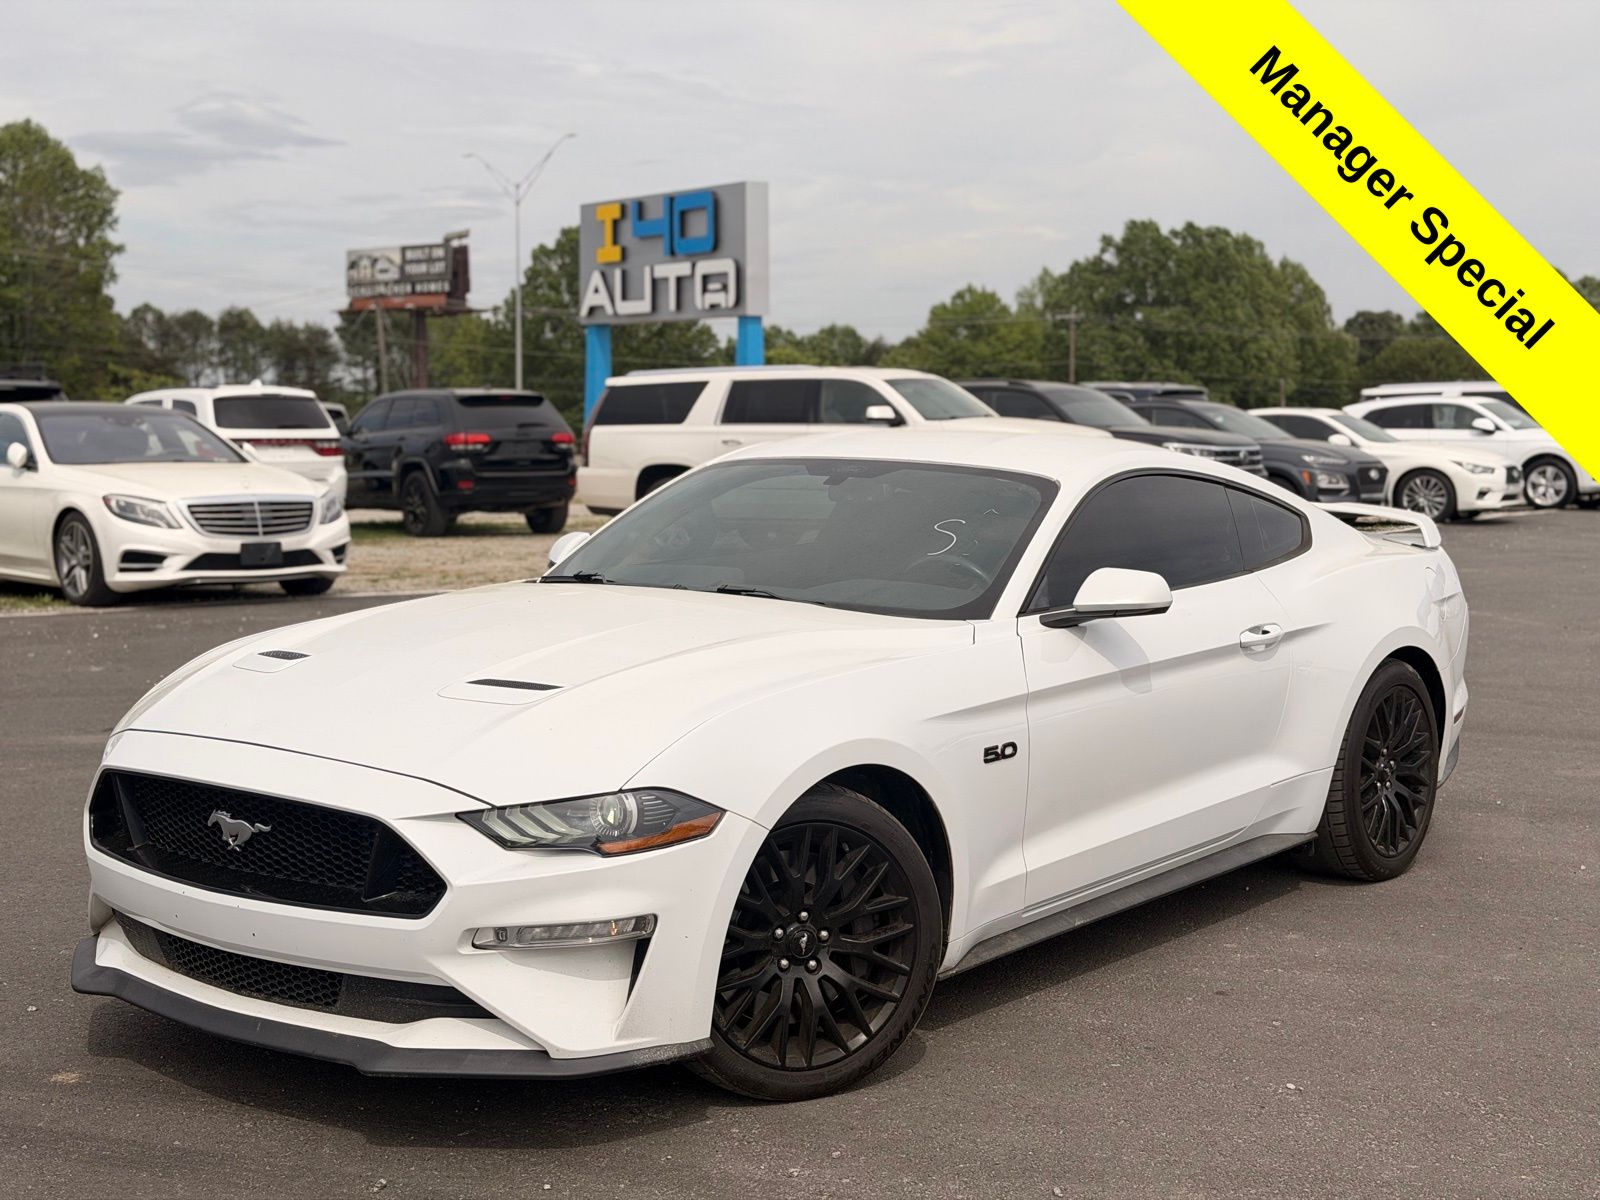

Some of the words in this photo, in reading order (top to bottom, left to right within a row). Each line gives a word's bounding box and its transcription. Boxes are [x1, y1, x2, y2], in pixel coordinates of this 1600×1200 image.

[632, 191, 716, 256] 40
[404, 262, 428, 275] YOUR
[428, 260, 446, 274] LOT
[579, 258, 738, 318] AUTO
